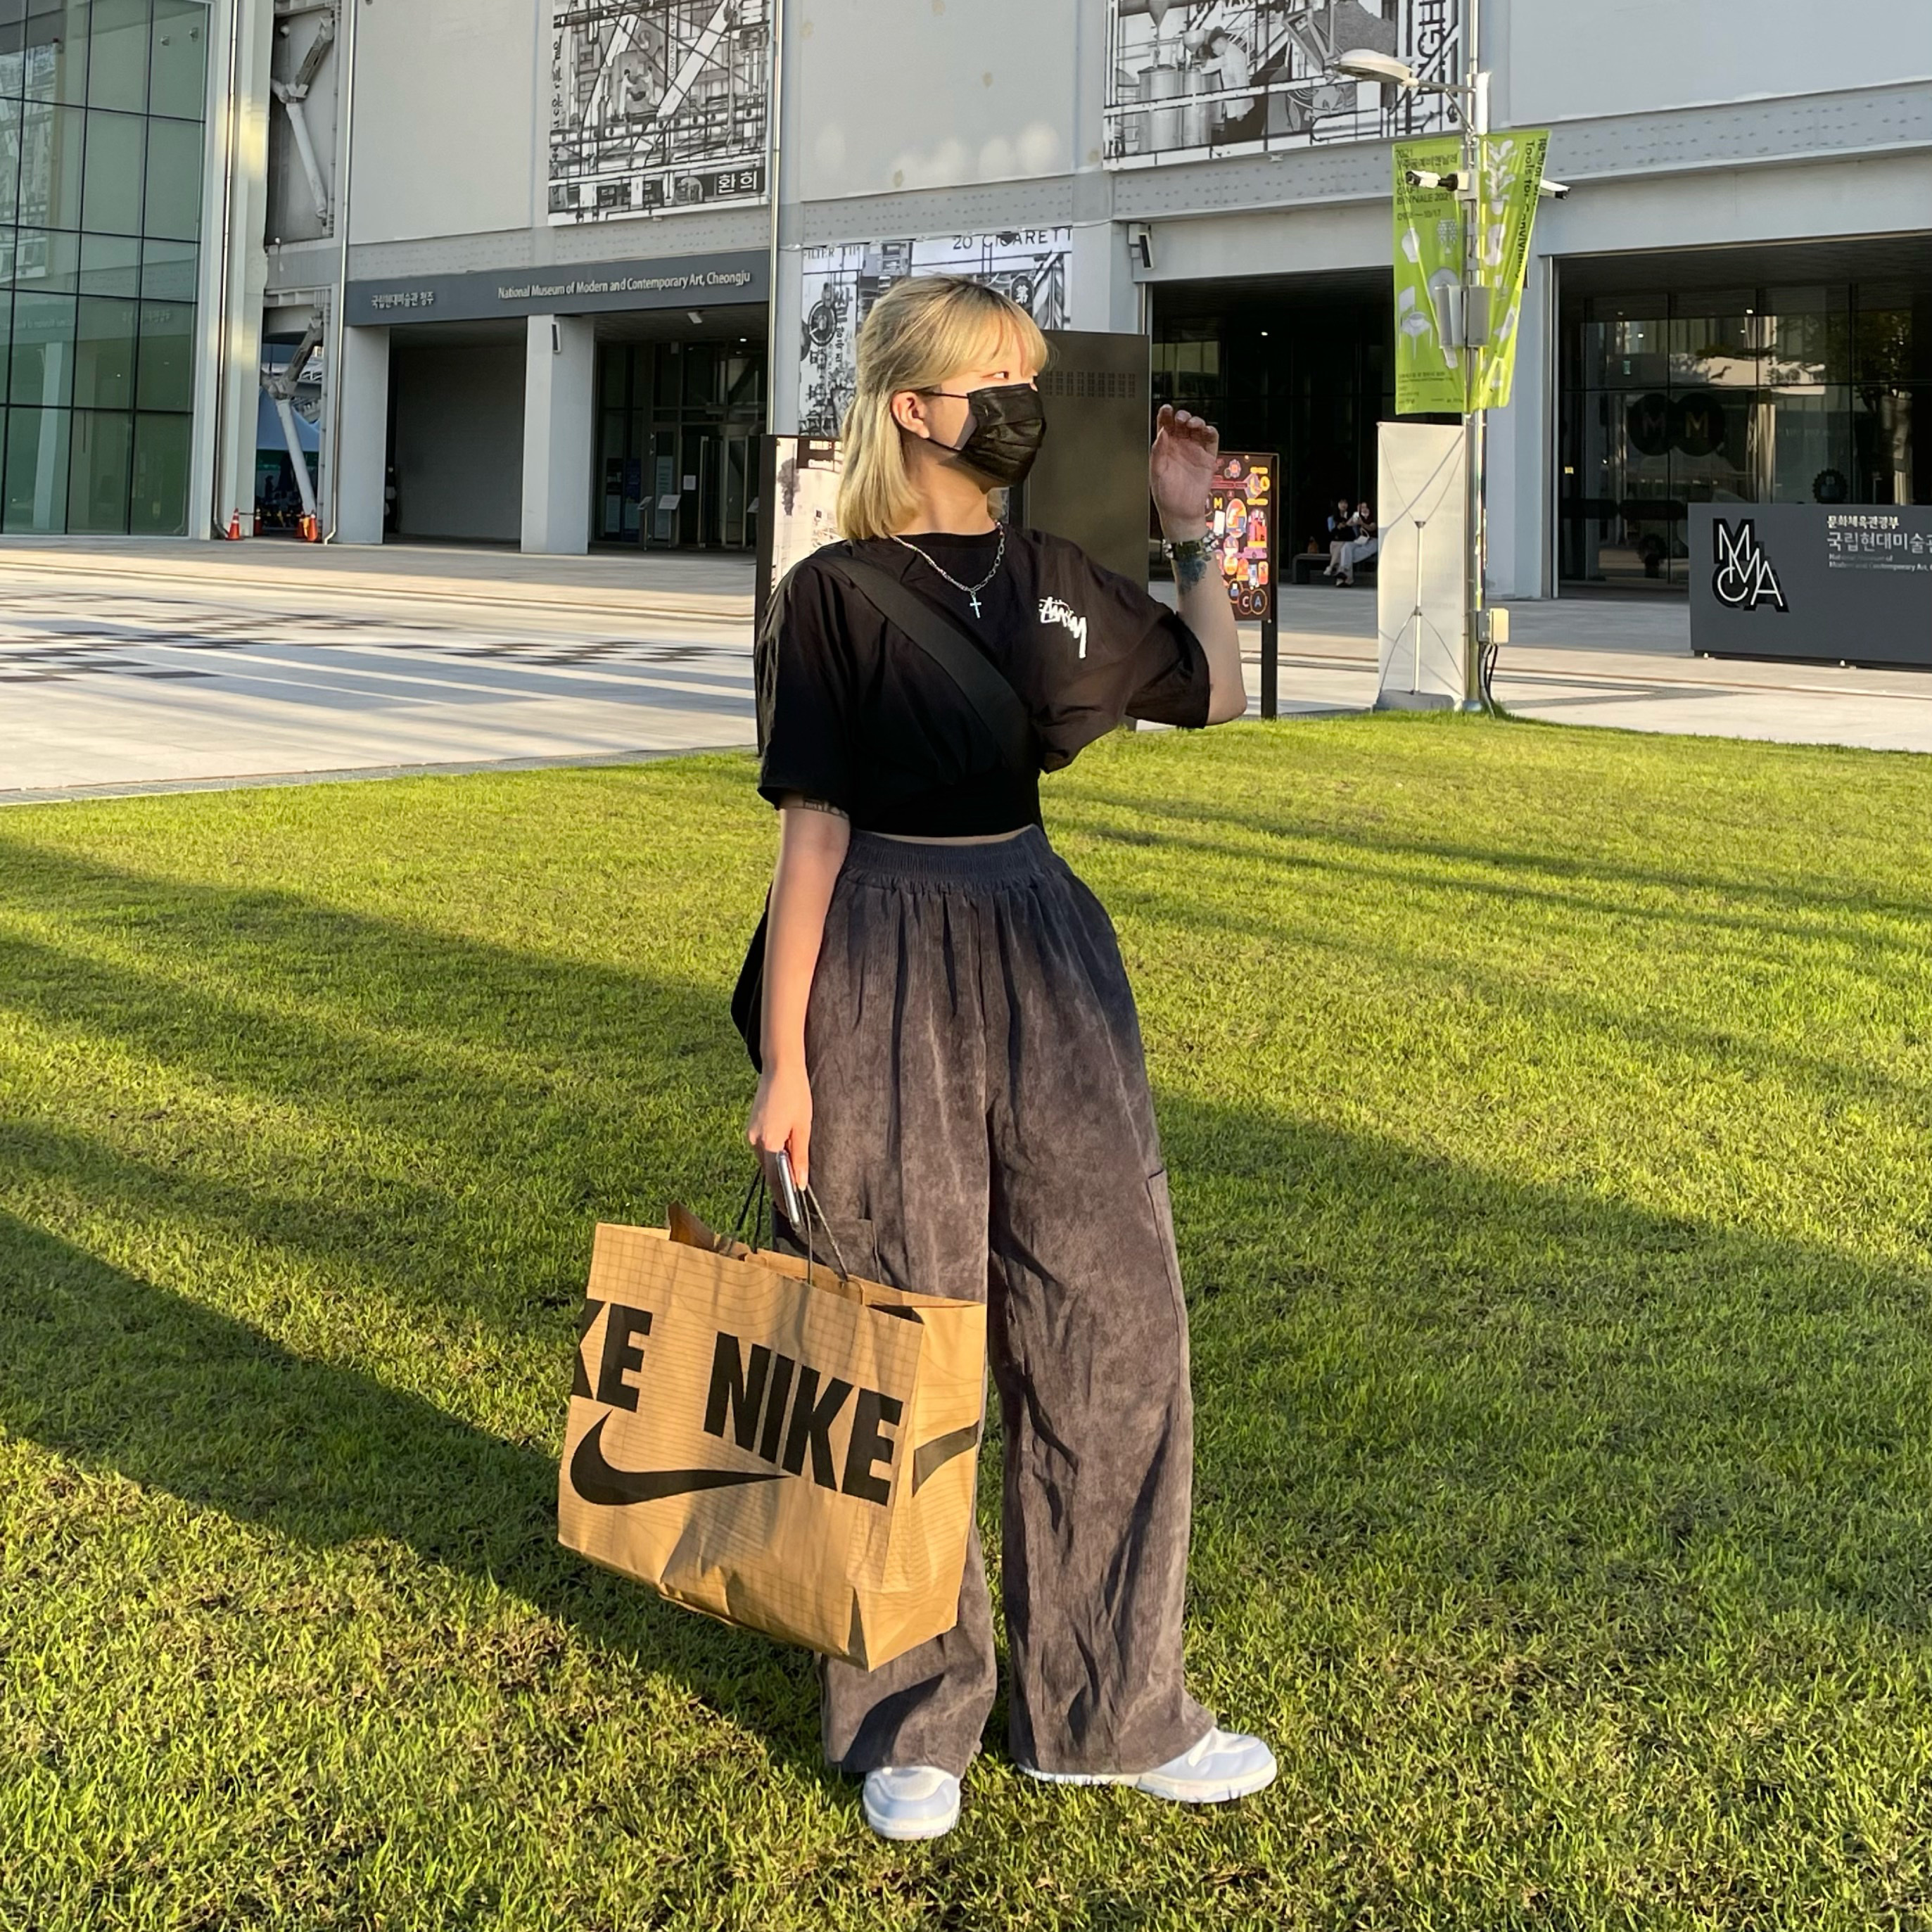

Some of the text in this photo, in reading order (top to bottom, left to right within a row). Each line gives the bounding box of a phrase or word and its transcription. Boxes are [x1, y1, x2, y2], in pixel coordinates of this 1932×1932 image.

[718, 170, 758, 194] 환희
[953, 236, 972, 250] 20
[498, 269, 751, 299] National Museum of Modern and Contemporary Art, Cheongju
[1827, 515, 1900, 529] 문화체육관광부
[704, 1330, 904, 1507] NIKE
